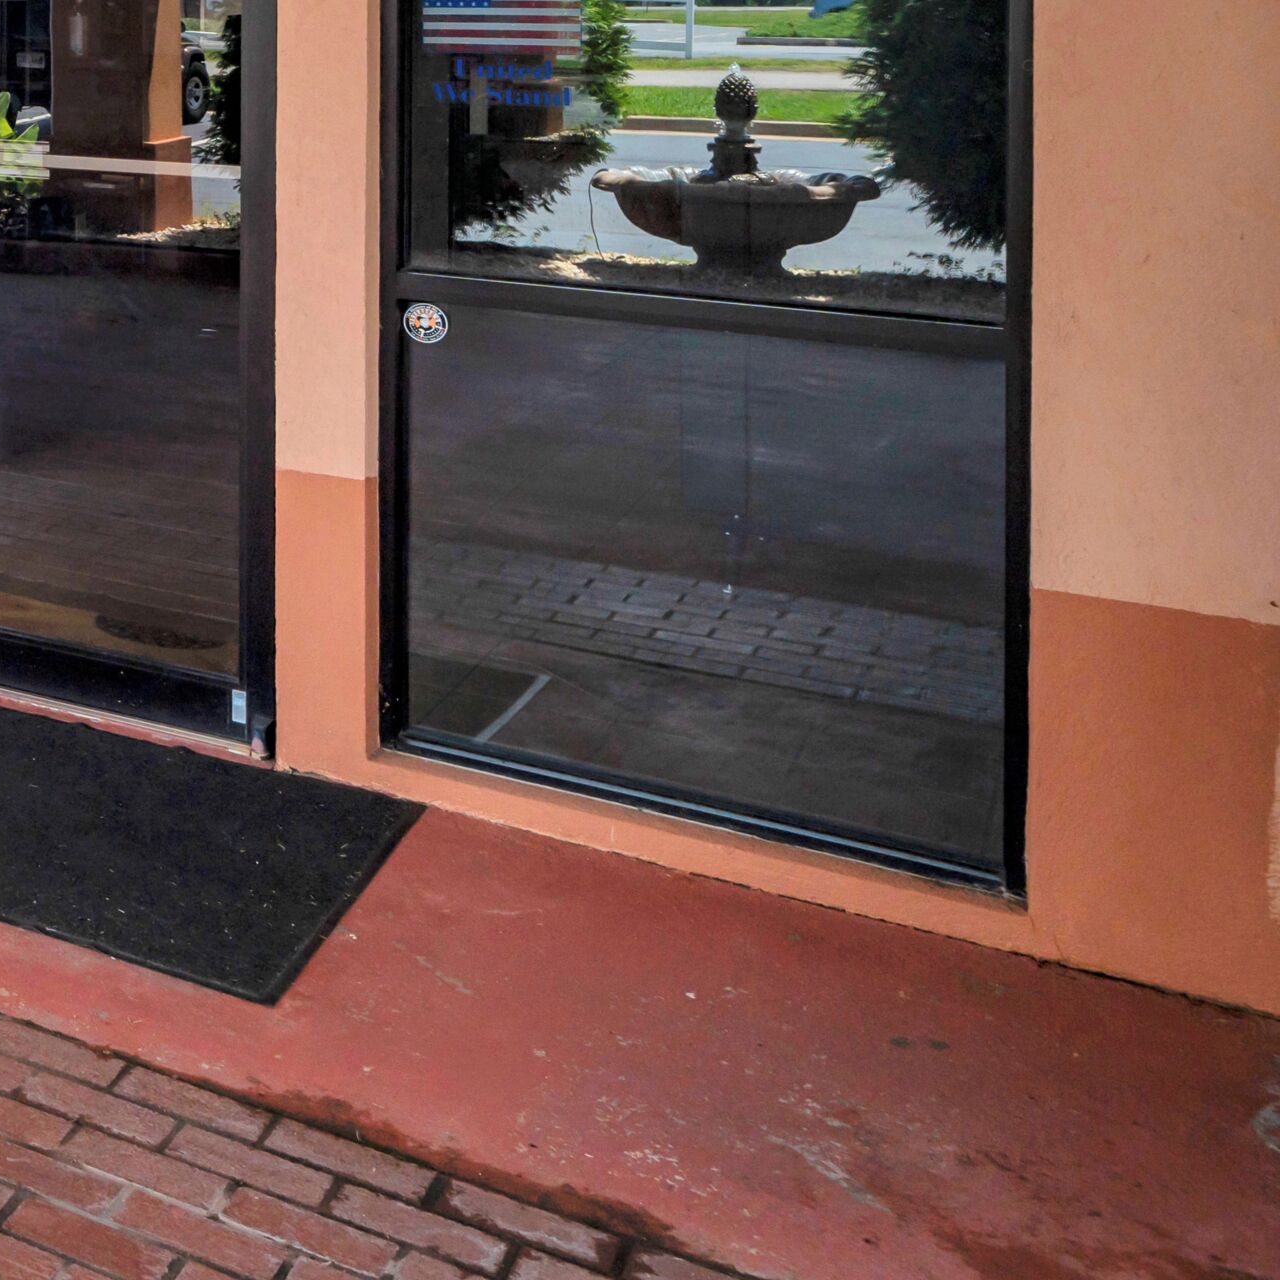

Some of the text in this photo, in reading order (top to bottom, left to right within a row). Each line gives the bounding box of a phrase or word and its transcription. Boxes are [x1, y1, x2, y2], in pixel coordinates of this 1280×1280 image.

[453, 57, 553, 81] United
[432, 82, 572, 107] We Stand
